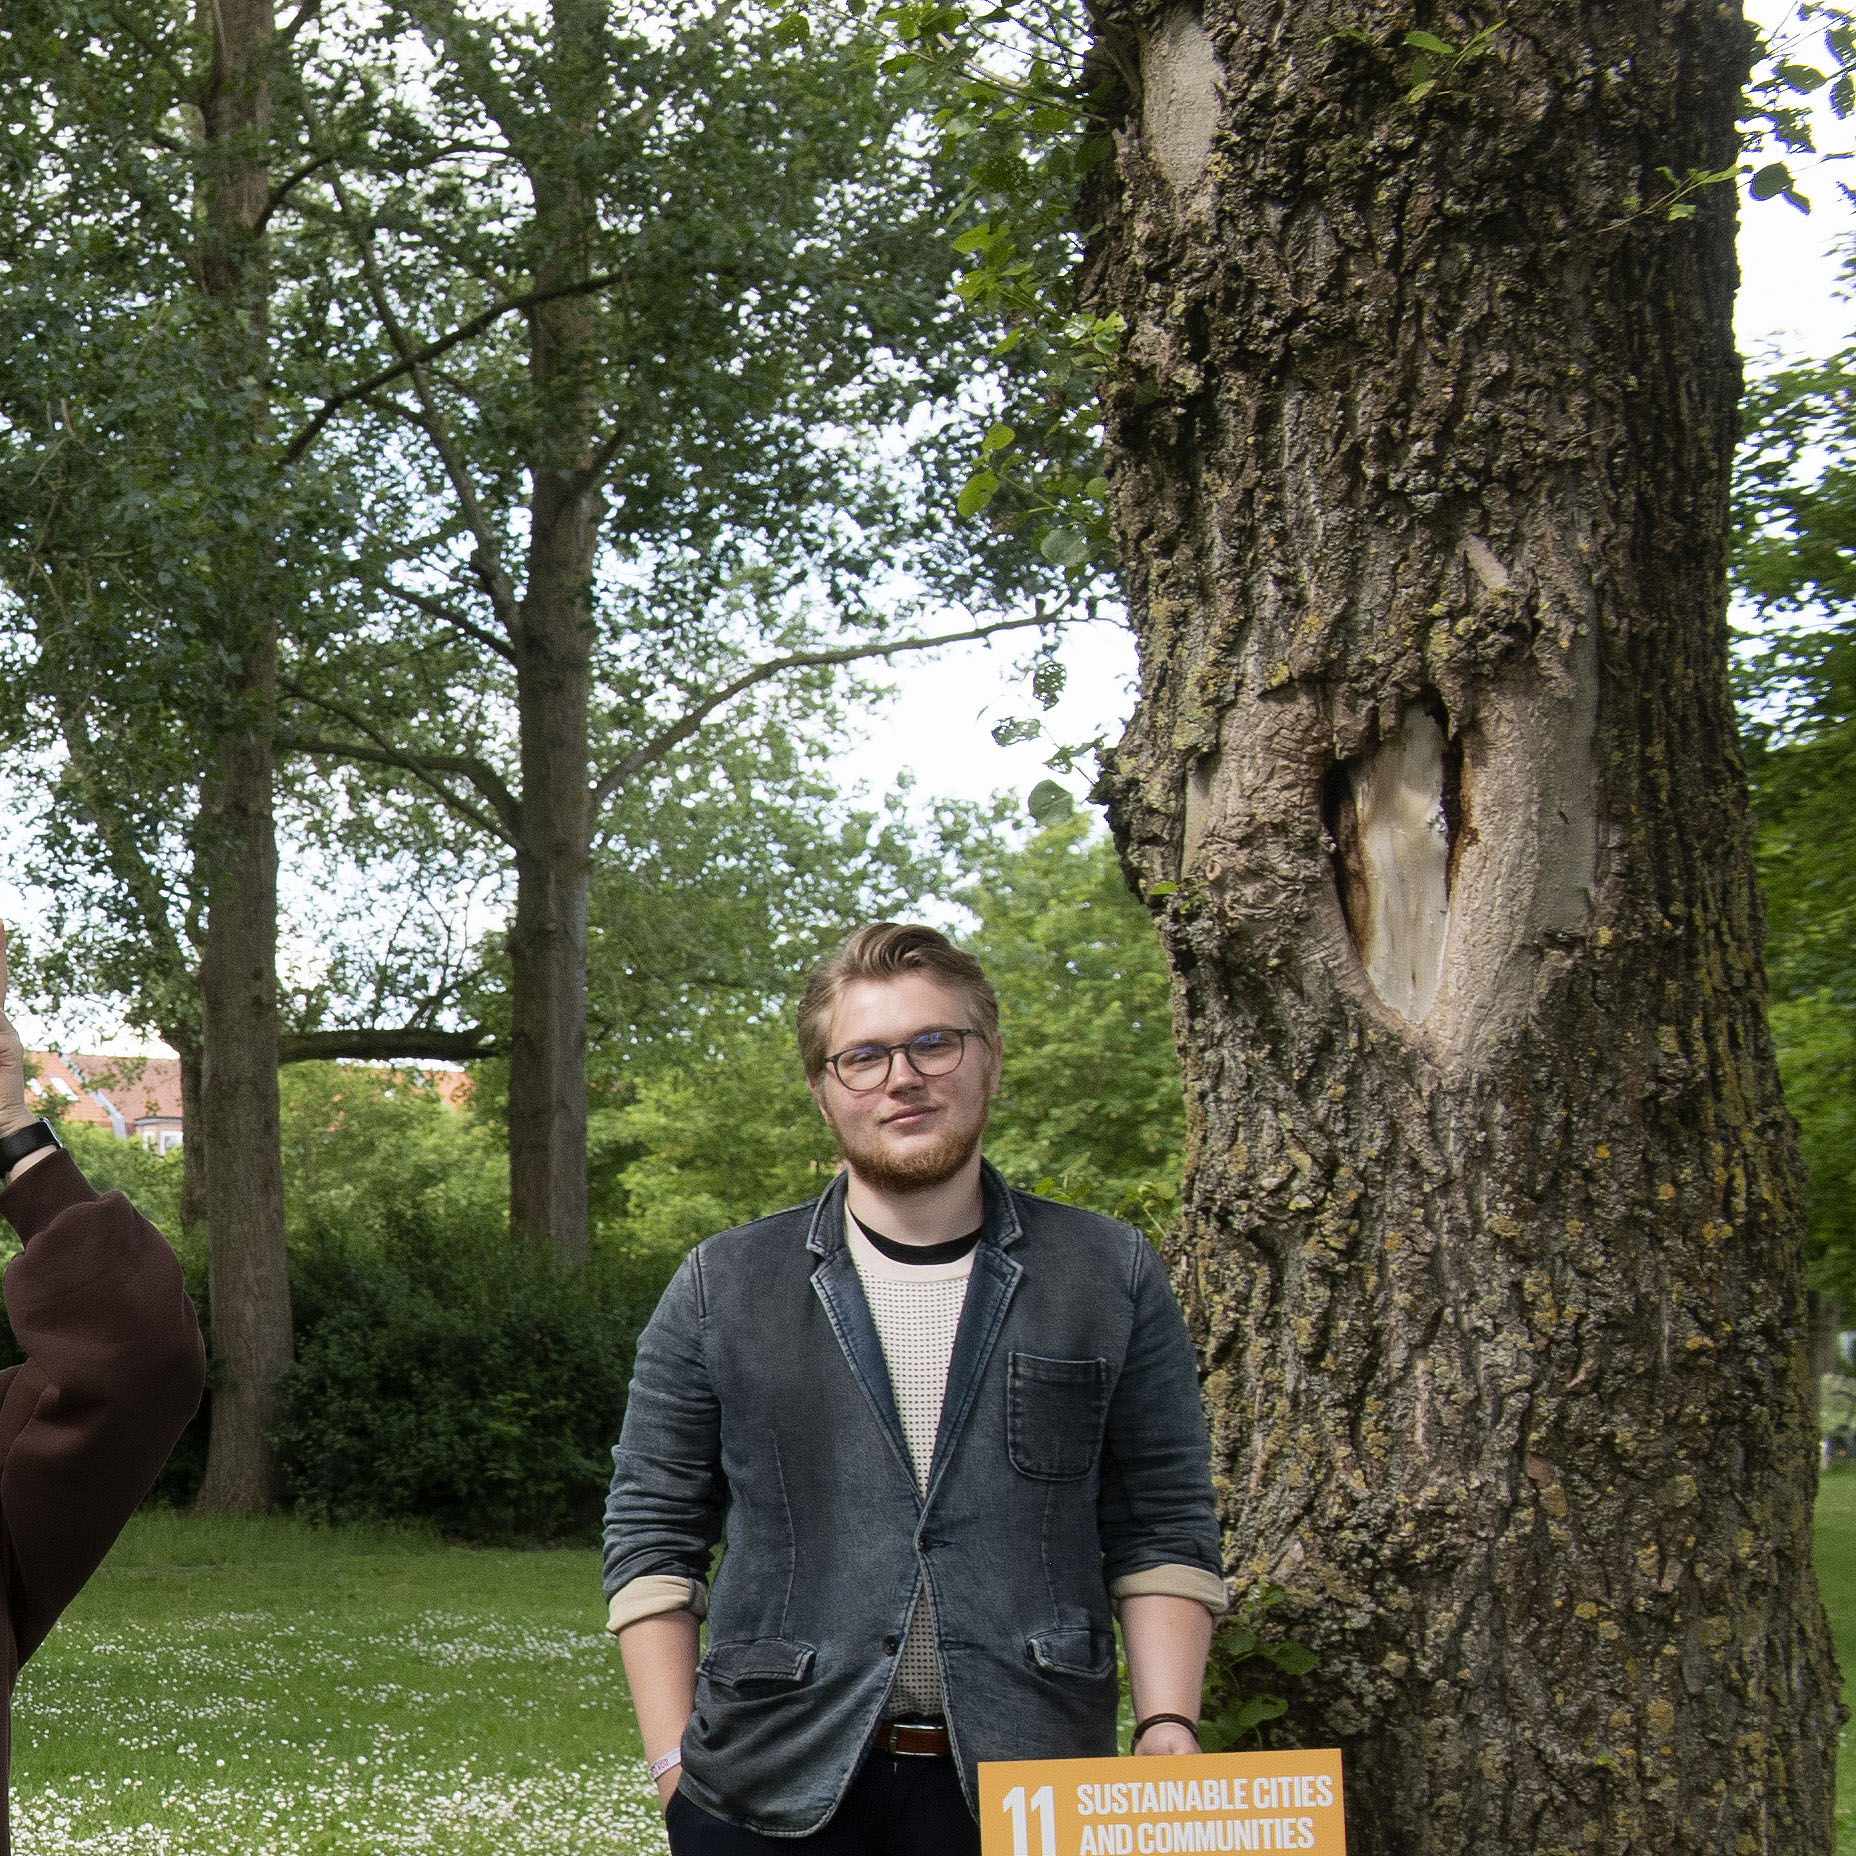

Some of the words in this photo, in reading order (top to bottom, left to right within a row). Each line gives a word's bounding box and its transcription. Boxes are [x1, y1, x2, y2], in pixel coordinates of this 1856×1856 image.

[1077, 1779, 1249, 1816] SUSTAINABLE
[1253, 1775, 1334, 1809] CITIES
[1080, 1824, 1134, 1856] AND
[1138, 1817, 1315, 1855] COMMUNITIES
